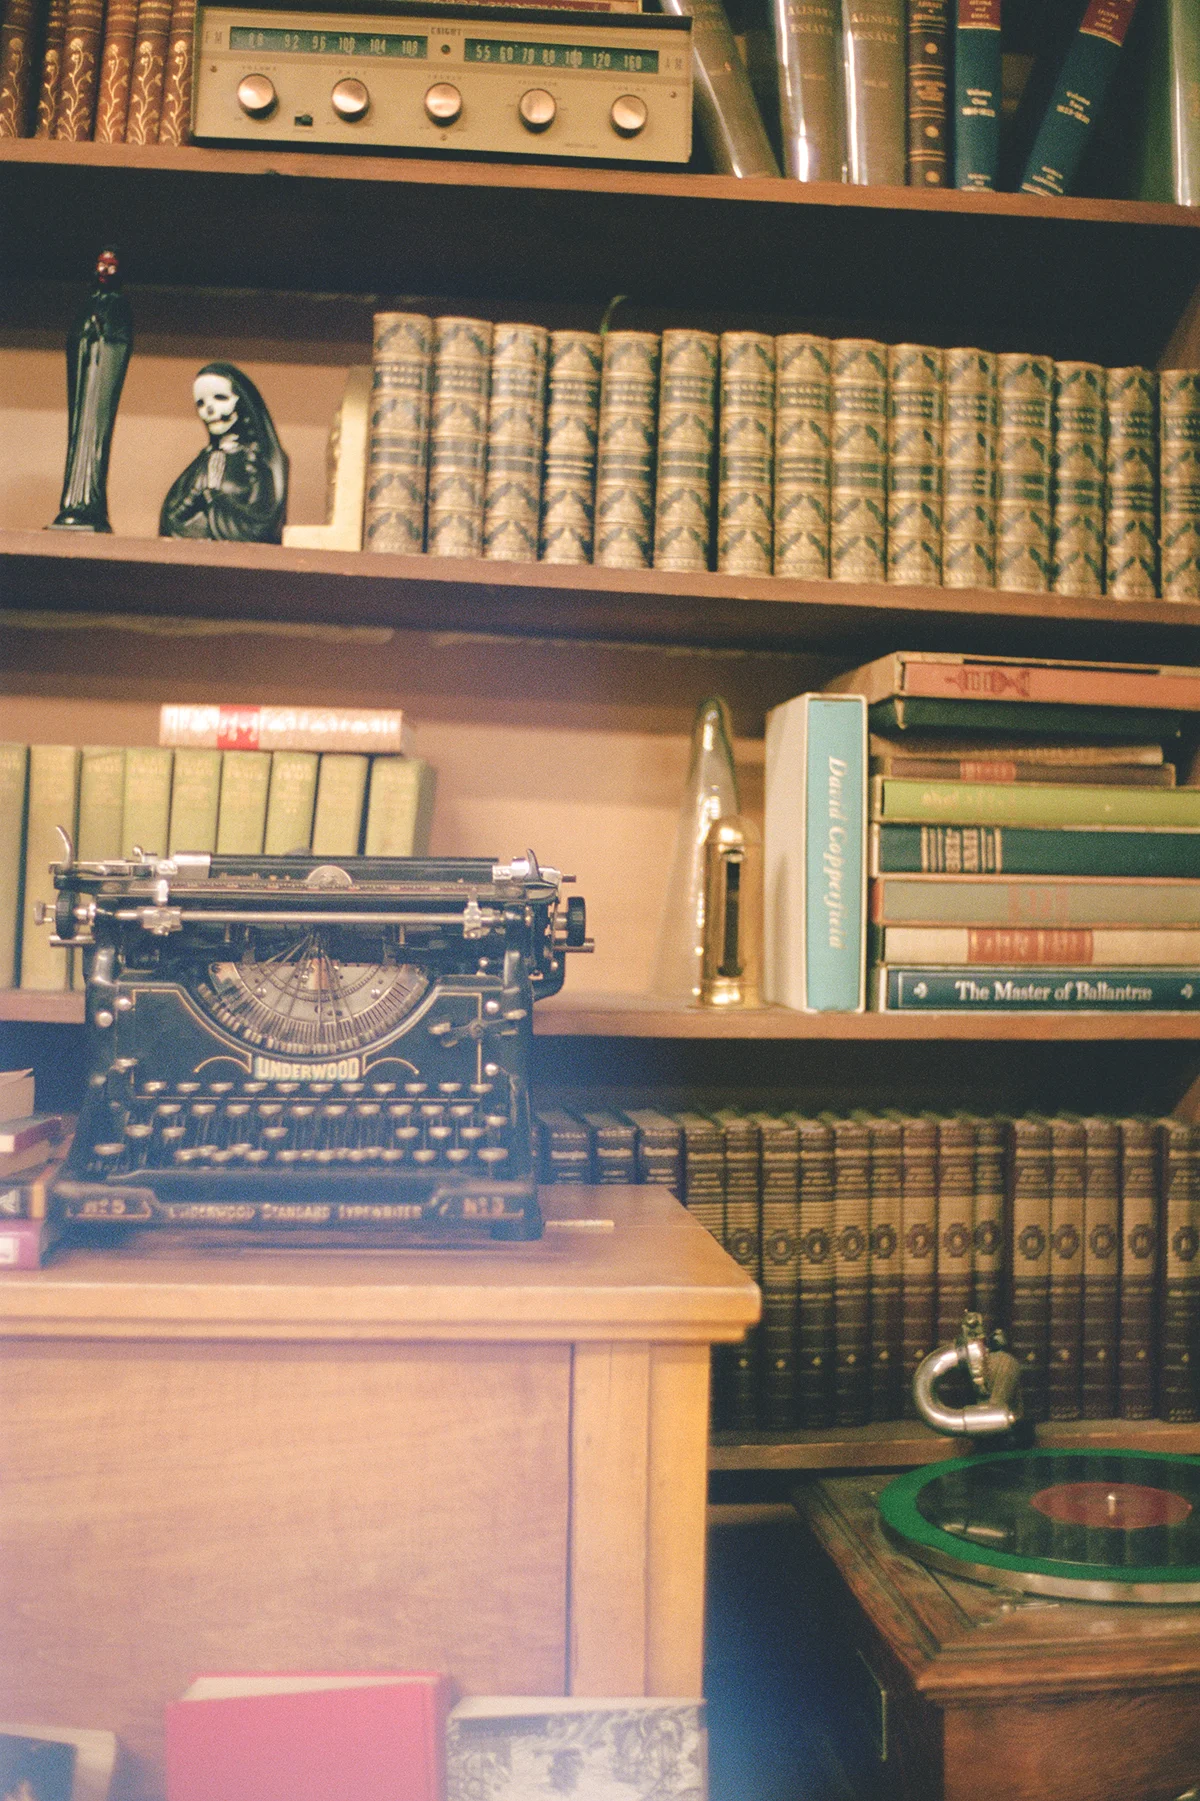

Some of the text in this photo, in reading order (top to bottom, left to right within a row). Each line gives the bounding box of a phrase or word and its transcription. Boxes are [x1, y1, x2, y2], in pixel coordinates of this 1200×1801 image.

[284, 34, 299, 49] 92
[312, 35, 326, 50] 96
[339, 37, 355, 52] 100
[370, 38, 386, 53] 104
[402, 40, 418, 55] 108
[476, 43, 491, 61] 55
[522, 47, 535, 64] 70
[592, 51, 611, 68] 120
[624, 54, 643, 71] 160
[823, 755, 848, 950] David Copperfield
[954, 980, 1153, 1000] The Master of Ballantrae
[255, 1056, 360, 1080] UNDERWOOD
[262, 1202, 331, 1220] STANDARD
[338, 1203, 423, 1220] TYPEWRITER
